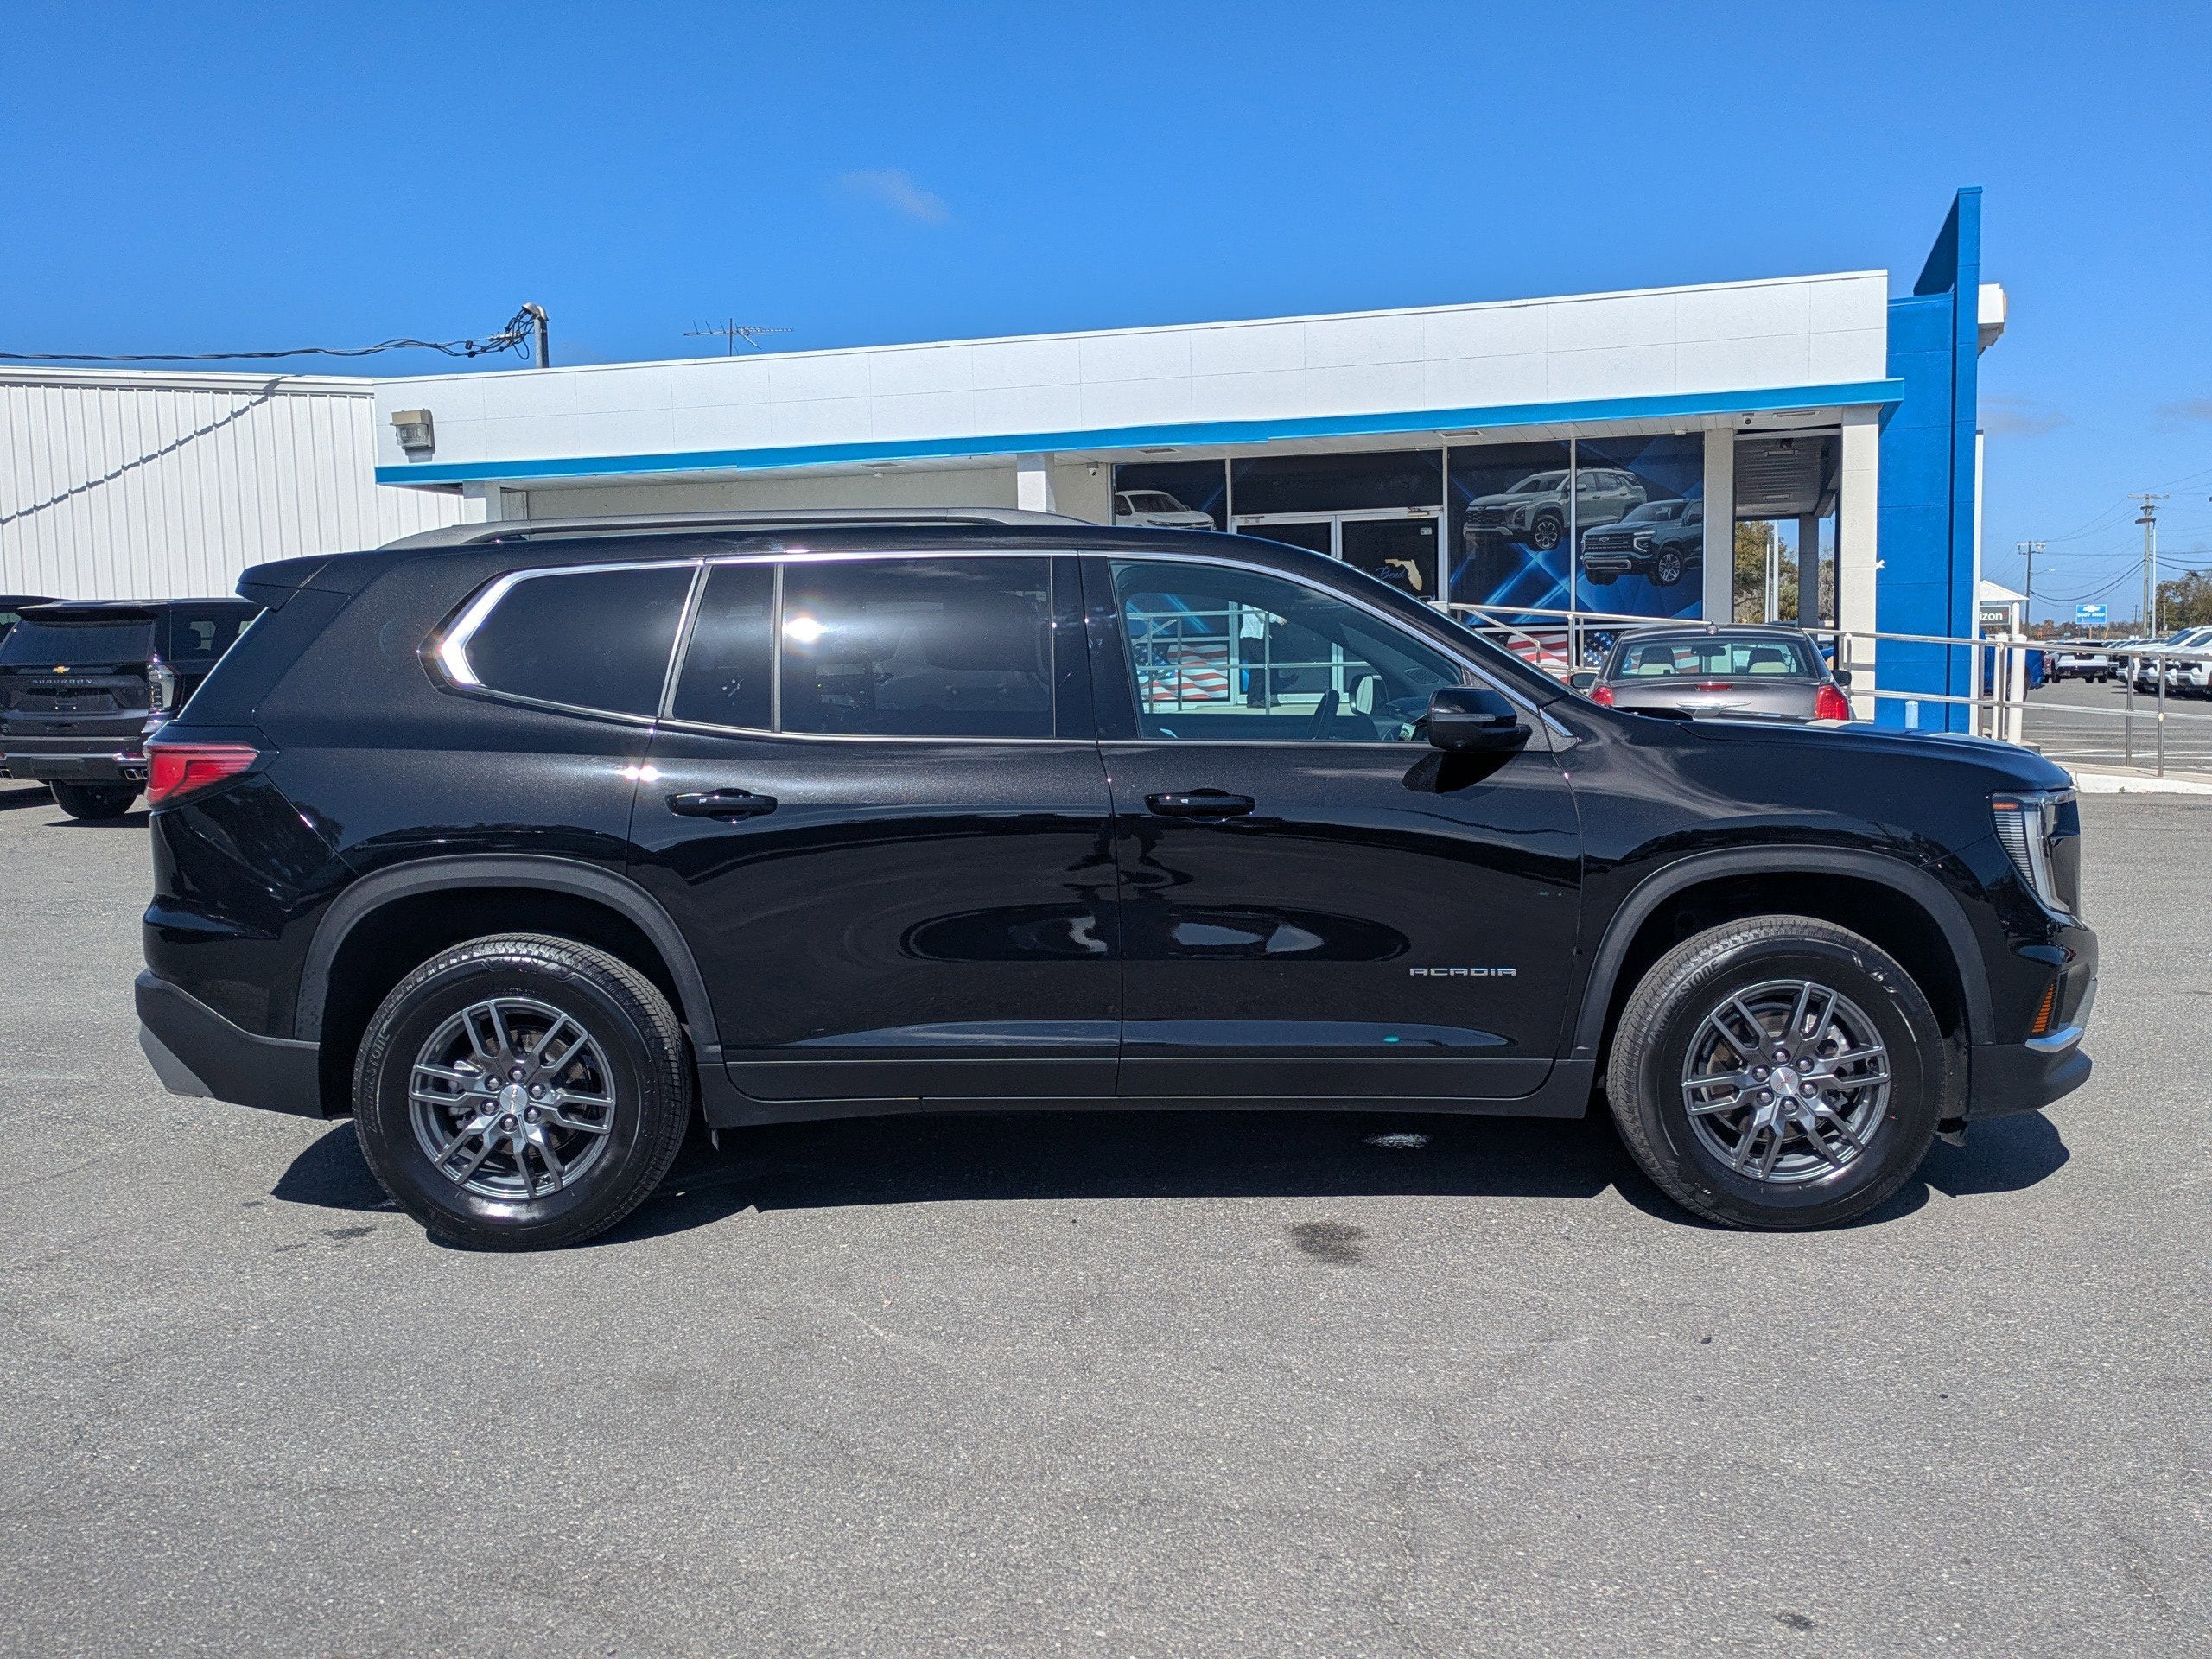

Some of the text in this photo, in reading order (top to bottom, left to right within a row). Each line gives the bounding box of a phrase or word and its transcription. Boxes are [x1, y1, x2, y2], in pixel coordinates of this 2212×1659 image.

[1376, 567, 1406, 579] Bend
[1980, 612, 2003, 621] izon
[1409, 968, 1516, 976] ACADIA
